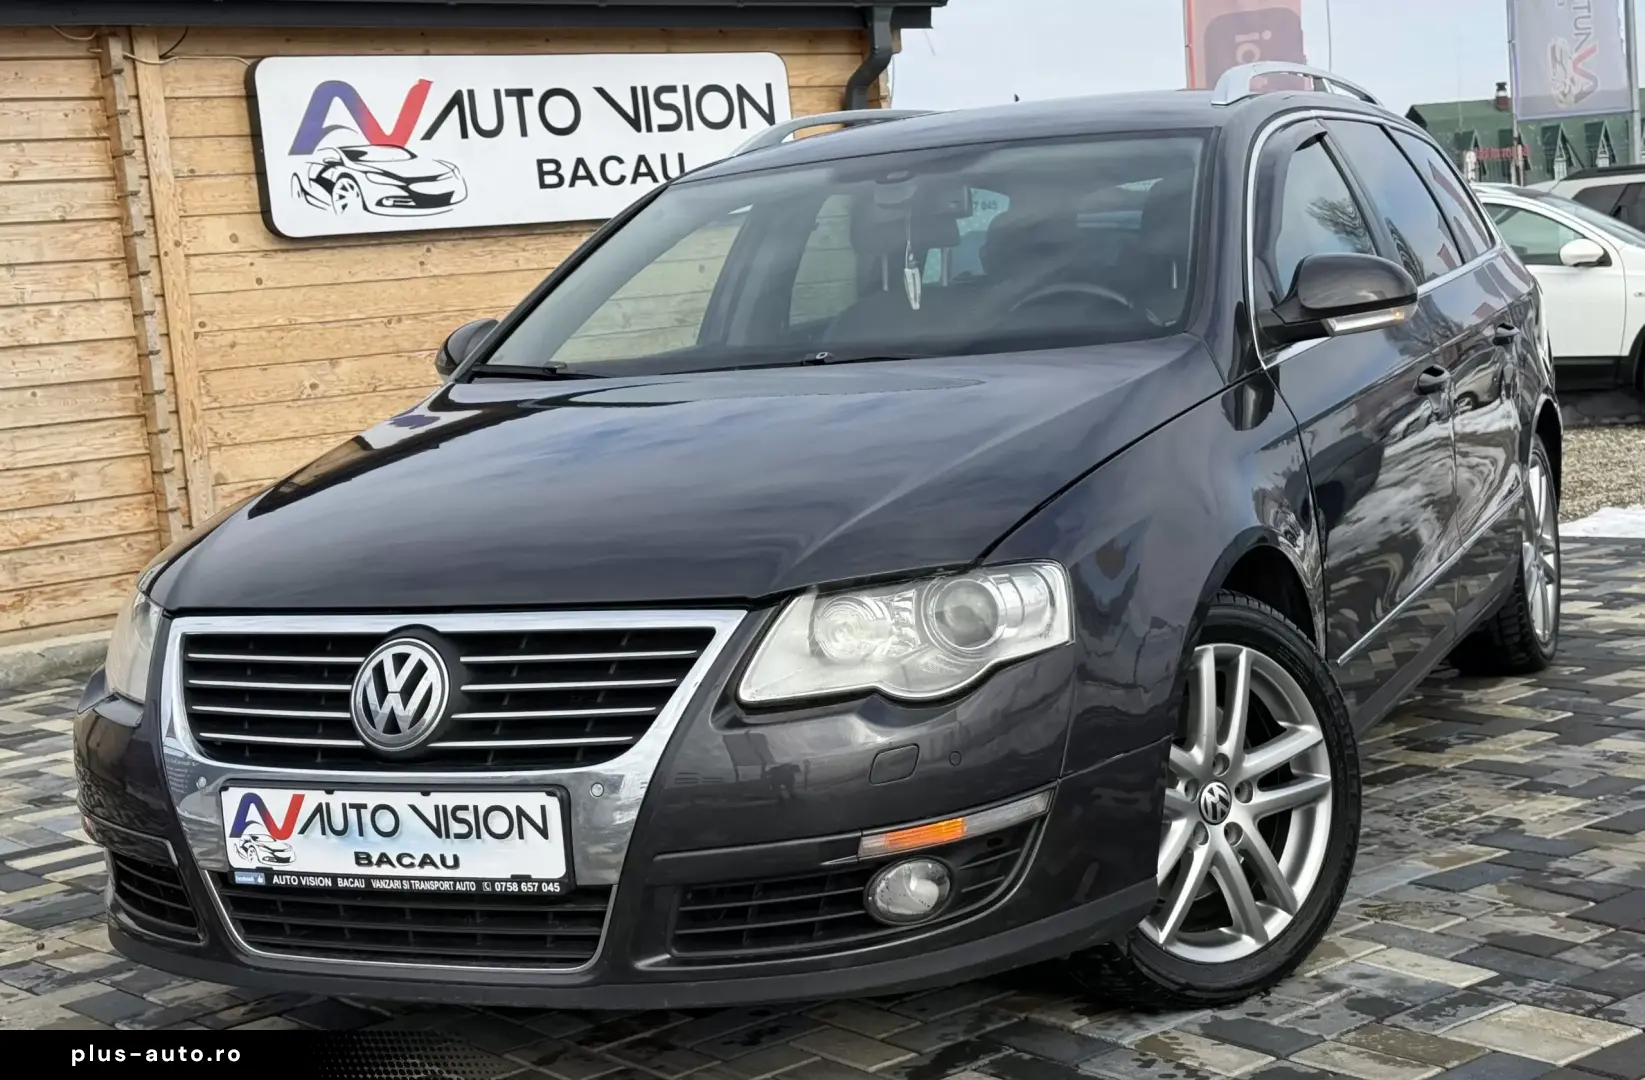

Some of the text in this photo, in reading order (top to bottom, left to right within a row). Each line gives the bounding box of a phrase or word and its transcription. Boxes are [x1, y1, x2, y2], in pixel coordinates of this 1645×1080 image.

[421, 82, 775, 141] AUTO VISION
[537, 152, 685, 190] BACAU
[298, 802, 549, 840] AUTO VISION
[354, 851, 460, 870] BACAU
[272, 874, 560, 893] AUTO VISION BACAU VANZARI SI TRANSPORT AUTO 0758 657 045
